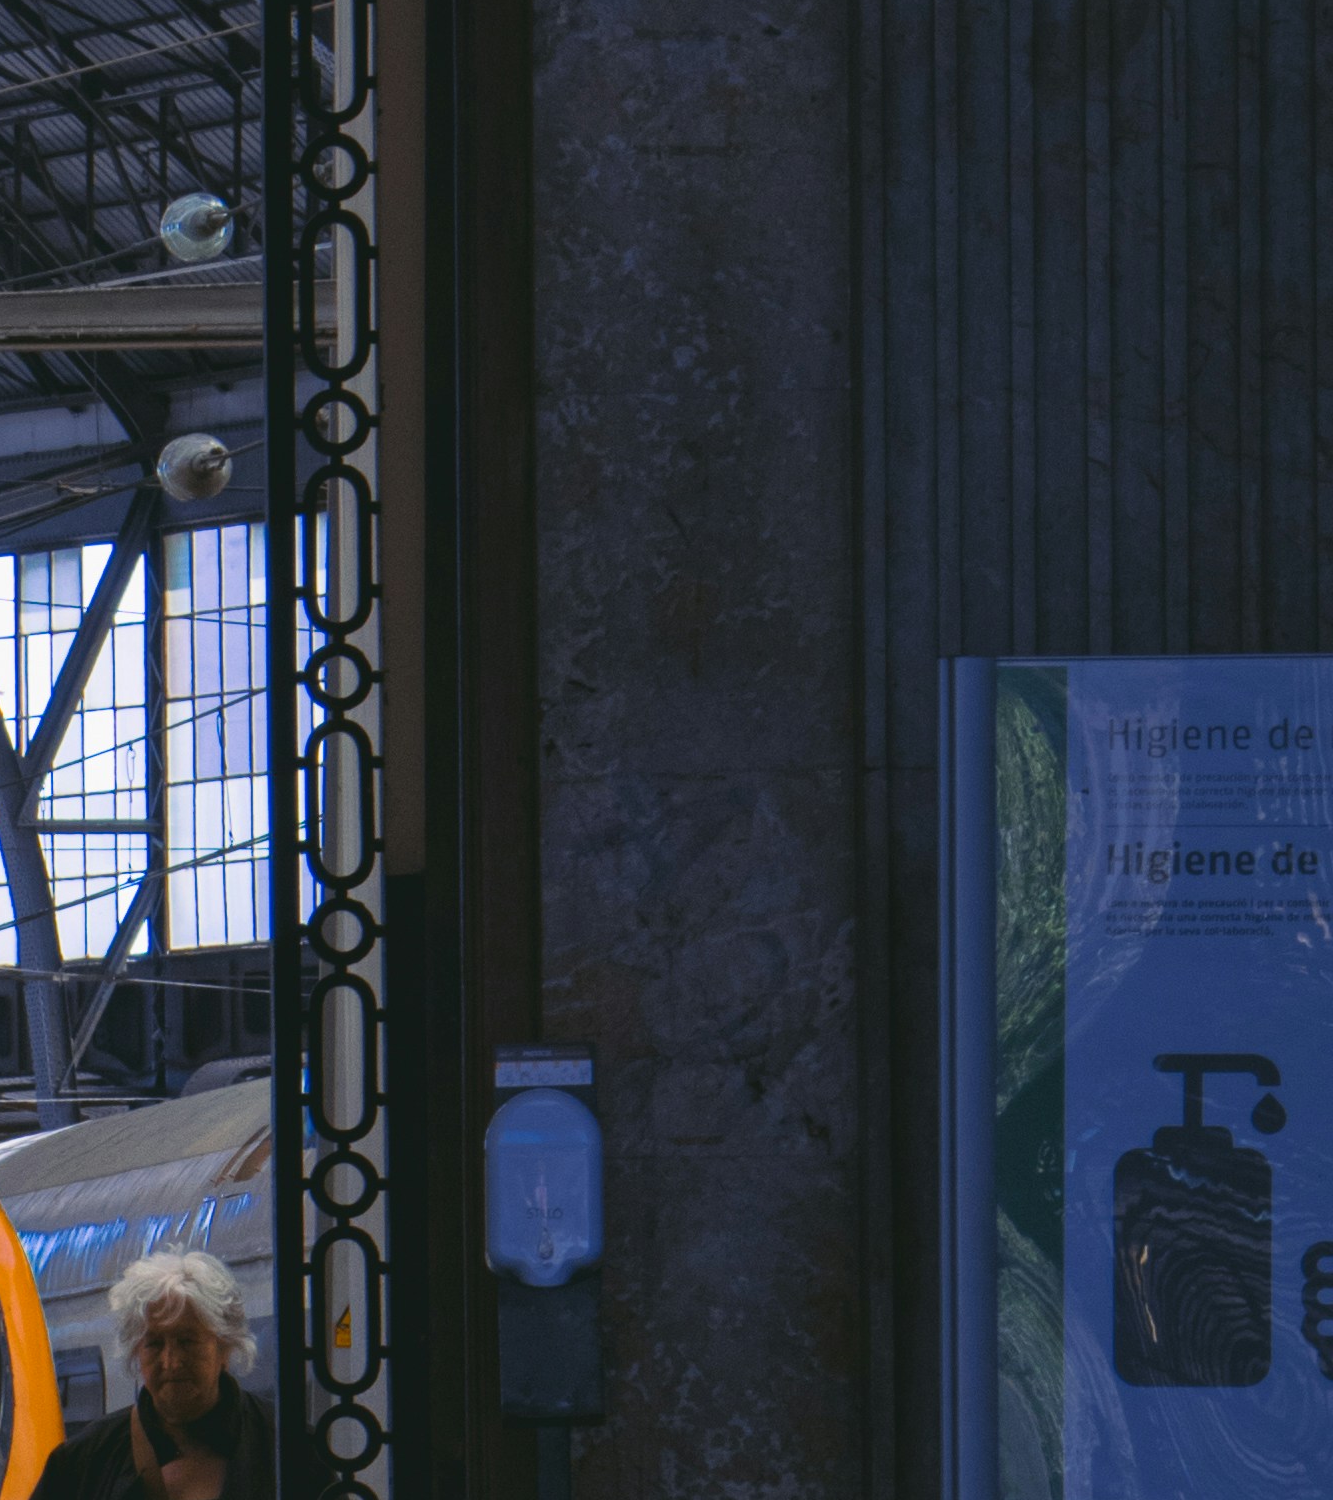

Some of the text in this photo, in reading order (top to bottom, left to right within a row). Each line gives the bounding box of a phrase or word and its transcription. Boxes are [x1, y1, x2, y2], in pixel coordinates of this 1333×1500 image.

[1109, 717, 1251, 758] Higiene
[1268, 717, 1314, 751] de
[1107, 841, 1318, 885] Higiene de
[1176, 914, 1197, 922] una
[1199, 913, 1241, 922] correcta
[1286, 912, 1300, 922] de
[1181, 899, 1195, 908] de
[1197, 898, 1247, 910] precaució
